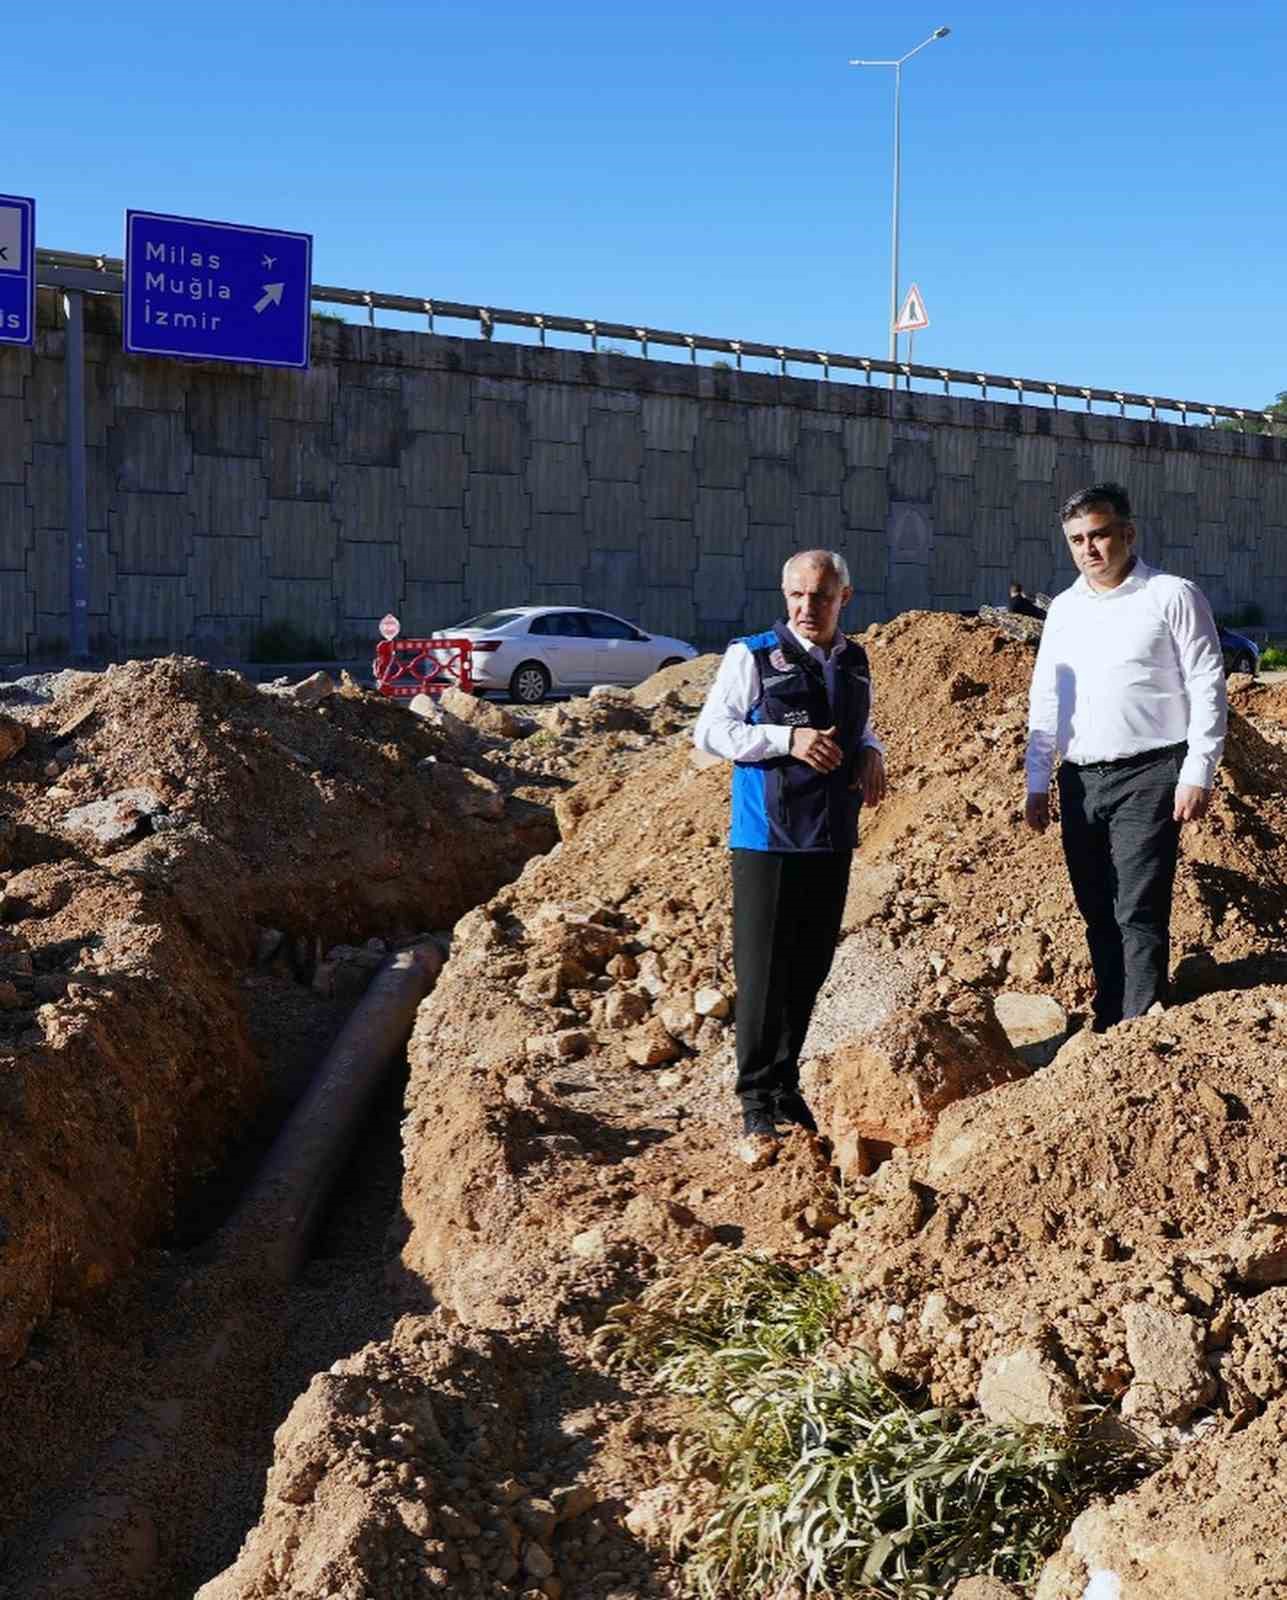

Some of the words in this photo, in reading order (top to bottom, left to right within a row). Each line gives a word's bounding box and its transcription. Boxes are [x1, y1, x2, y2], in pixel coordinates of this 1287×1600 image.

[145, 241, 221, 270] Milas
[145, 271, 231, 300] Muğla
[145, 299, 221, 331] İzmir
